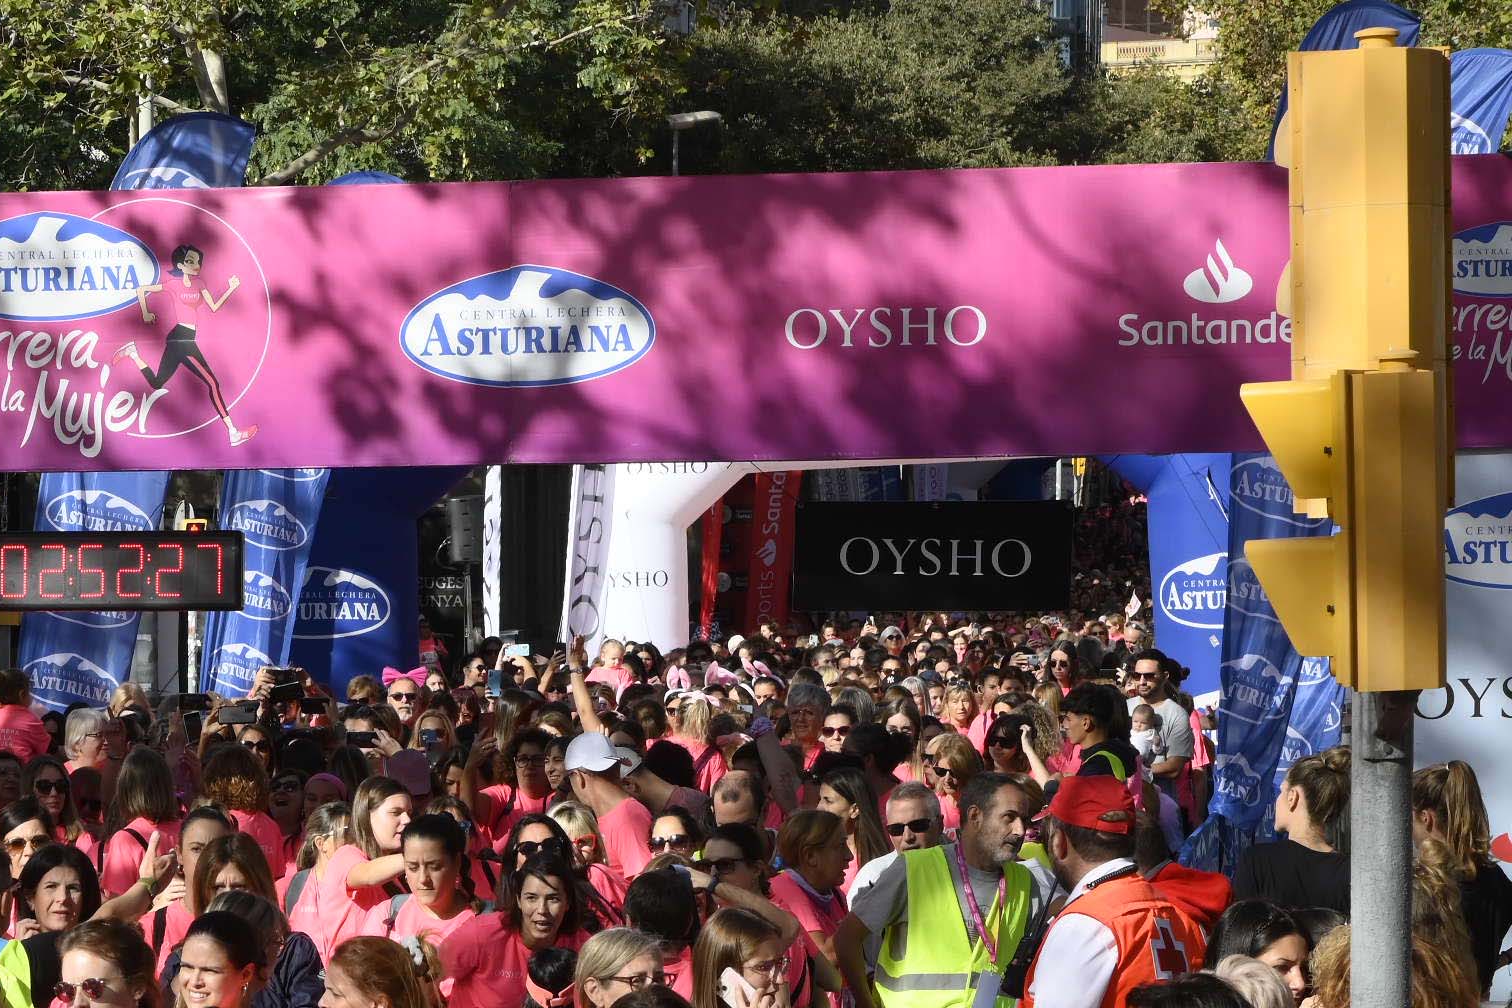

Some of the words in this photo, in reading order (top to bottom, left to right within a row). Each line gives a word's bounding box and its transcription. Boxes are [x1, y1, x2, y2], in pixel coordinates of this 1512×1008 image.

[62, 249, 136, 260] LECHERA
[1452, 260, 1512, 278] STUR
[459, 308, 538, 320] CENTRAL
[546, 306, 627, 319] LECHERA
[784, 305, 987, 349] OYSHO
[1118, 313, 1293, 346] Santande
[420, 312, 635, 357] ASTURIANA
[1468, 333, 1486, 360] la
[0, 372, 25, 412] la
[20, 364, 169, 458] Mujer
[762, 471, 788, 534] Santa
[1236, 470, 1293, 505] ASTU
[232, 510, 298, 544] ASTURIANA
[569, 464, 607, 641] OYSH
[839, 536, 1032, 577] OYSHO
[0, 543, 222, 599] 02:52:27
[608, 570, 669, 588] YSHO
[1183, 579, 1226, 588] CENTRA
[244, 592, 284, 614] URIANA
[299, 601, 380, 621] URIANA
[328, 591, 376, 599] LECHERA
[757, 571, 775, 626] ports
[1166, 582, 1226, 610] ASTU
[31, 666, 112, 701] ASTURIANA
[211, 661, 257, 682] ASTURIA
